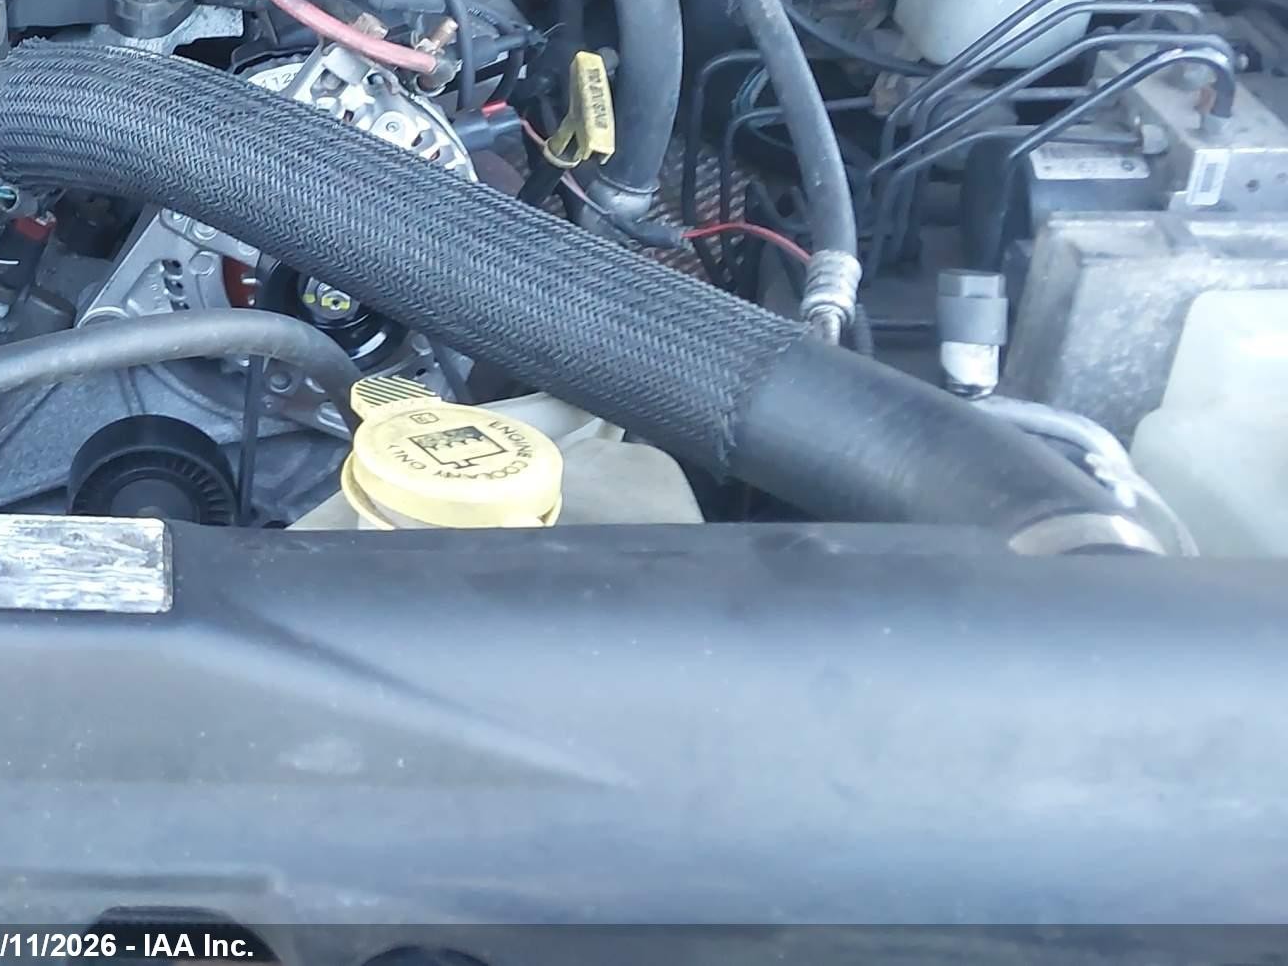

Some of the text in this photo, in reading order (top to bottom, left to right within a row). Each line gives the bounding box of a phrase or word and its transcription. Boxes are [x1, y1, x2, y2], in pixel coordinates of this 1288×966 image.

[387, 420, 534, 480] ENGINE COOLANT ONLY
